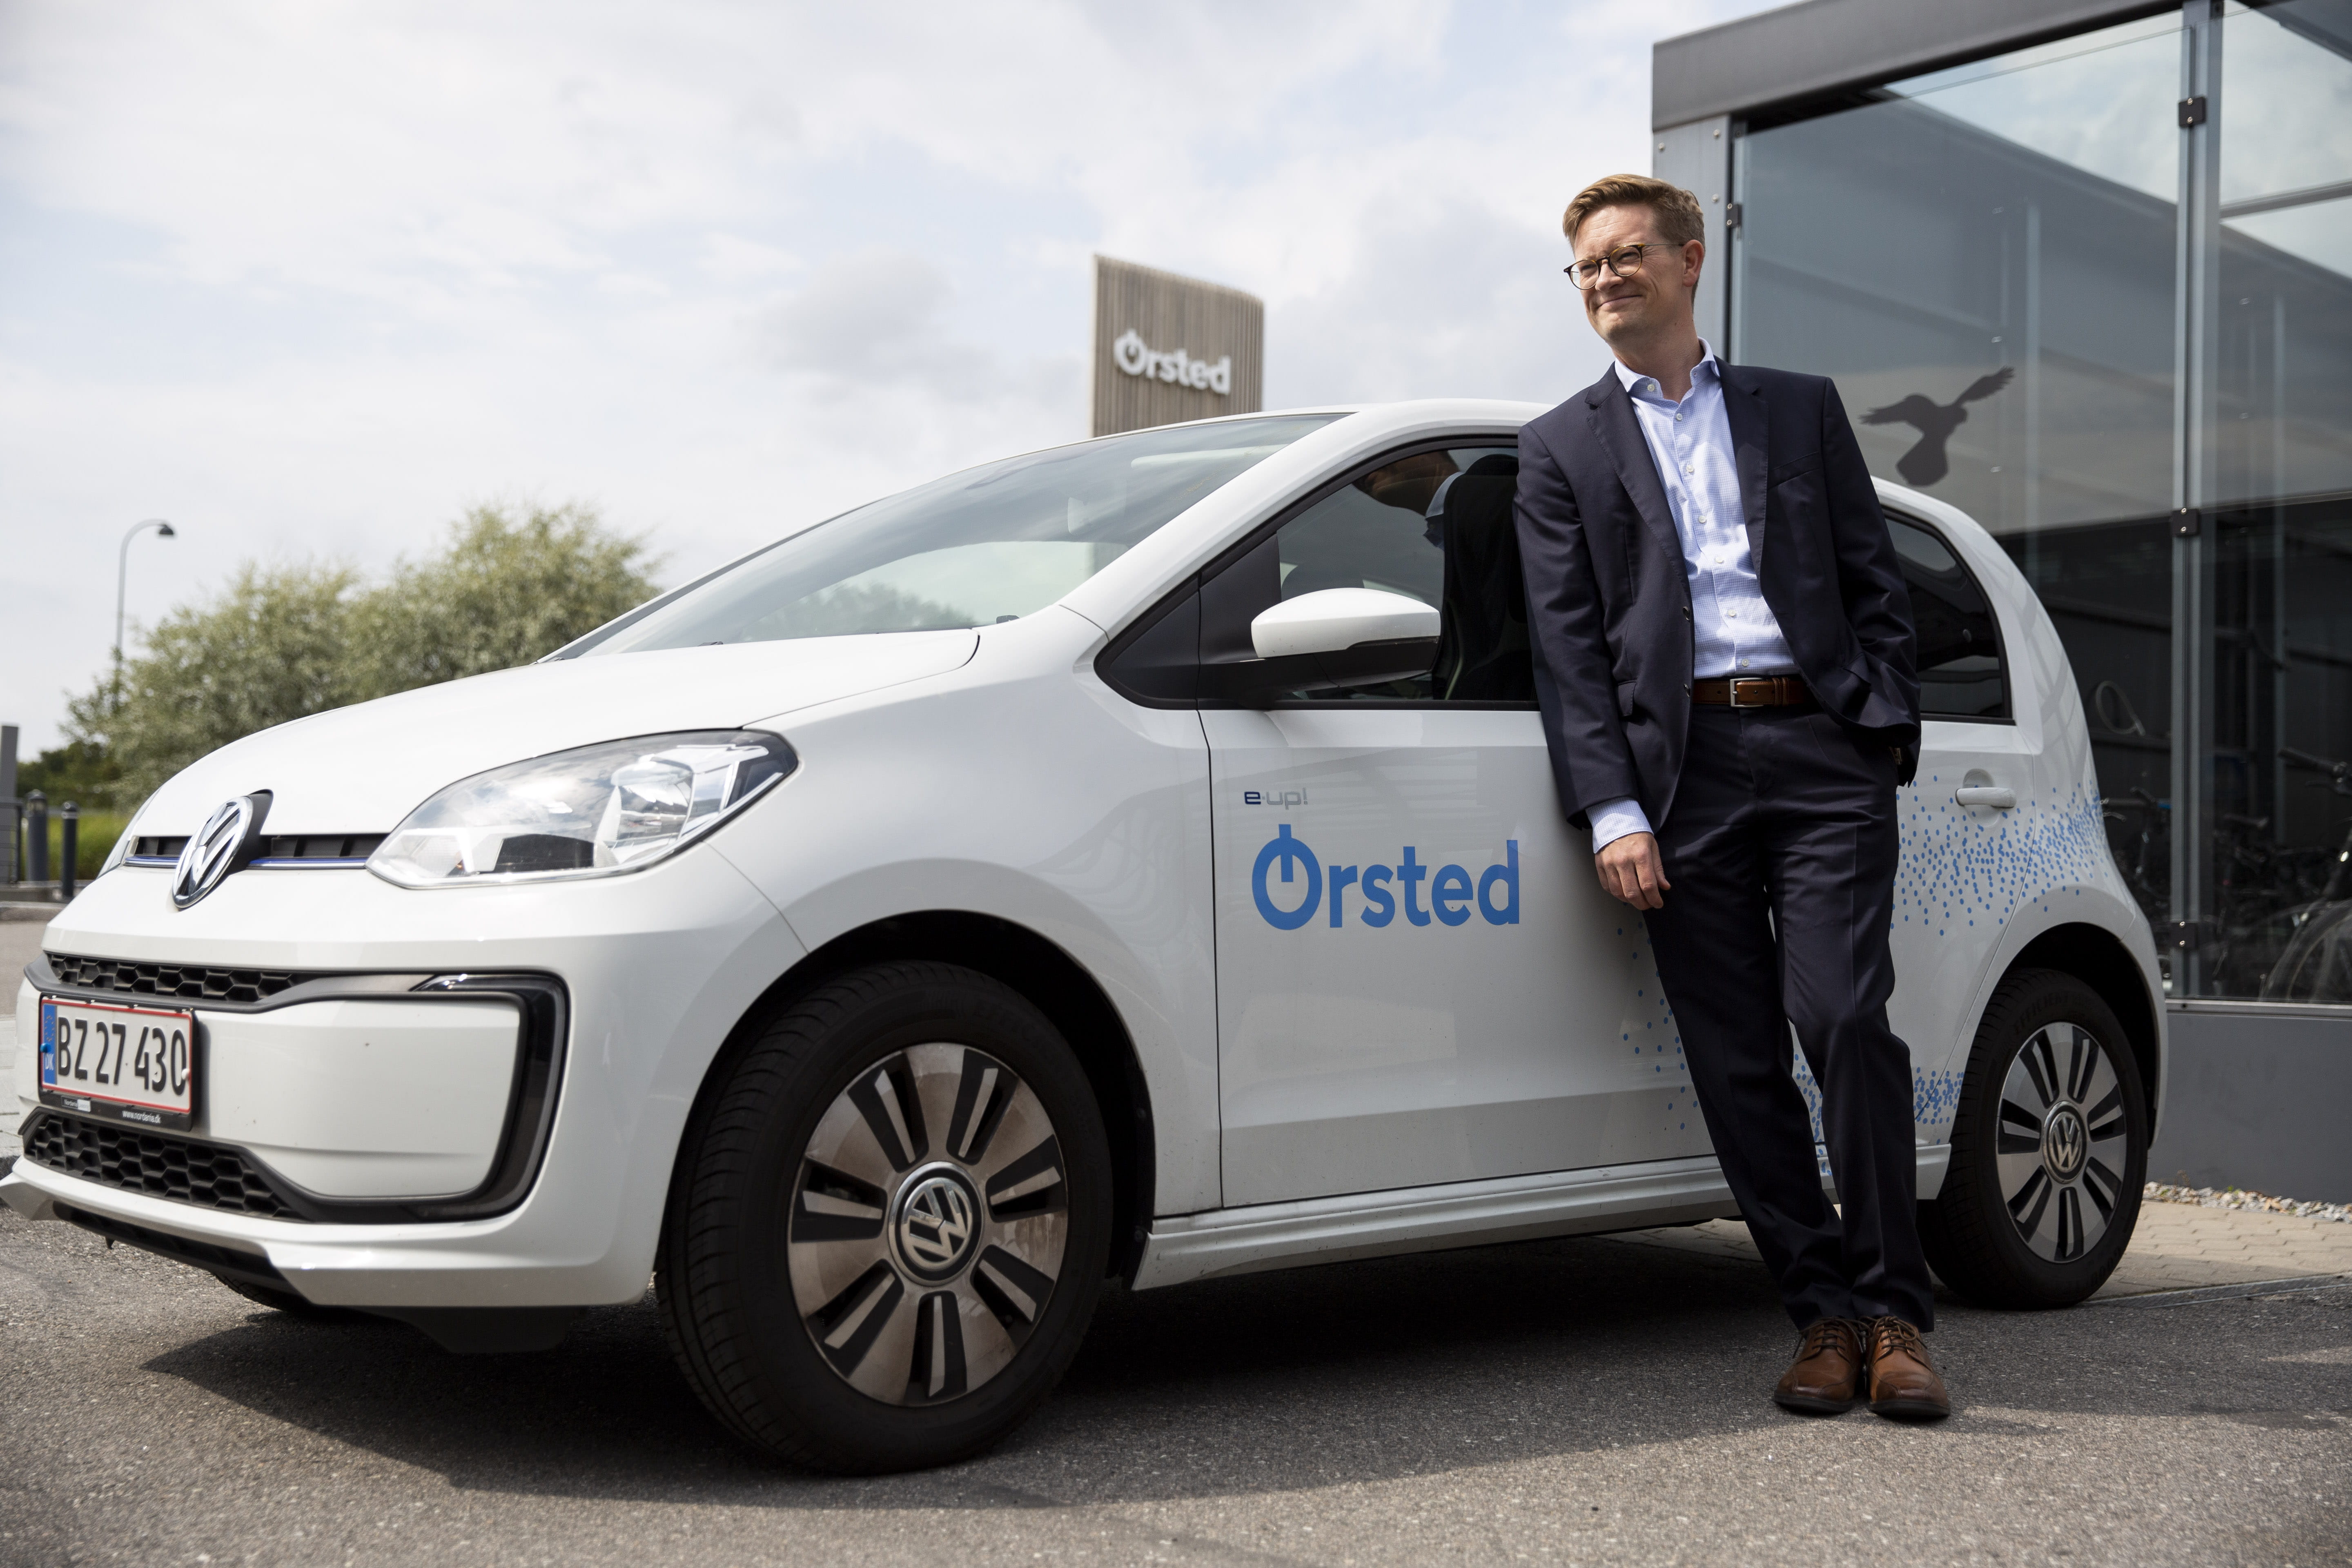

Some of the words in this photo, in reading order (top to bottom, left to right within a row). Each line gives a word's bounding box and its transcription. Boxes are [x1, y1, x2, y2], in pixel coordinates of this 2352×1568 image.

[45, 1054, 54, 1070] DK
[58, 1017, 87, 1080] BZ
[96, 1022, 126, 1085] 27
[135, 1026, 187, 1096] 430
[122, 1110, 161, 1123] www.nordania.dk
